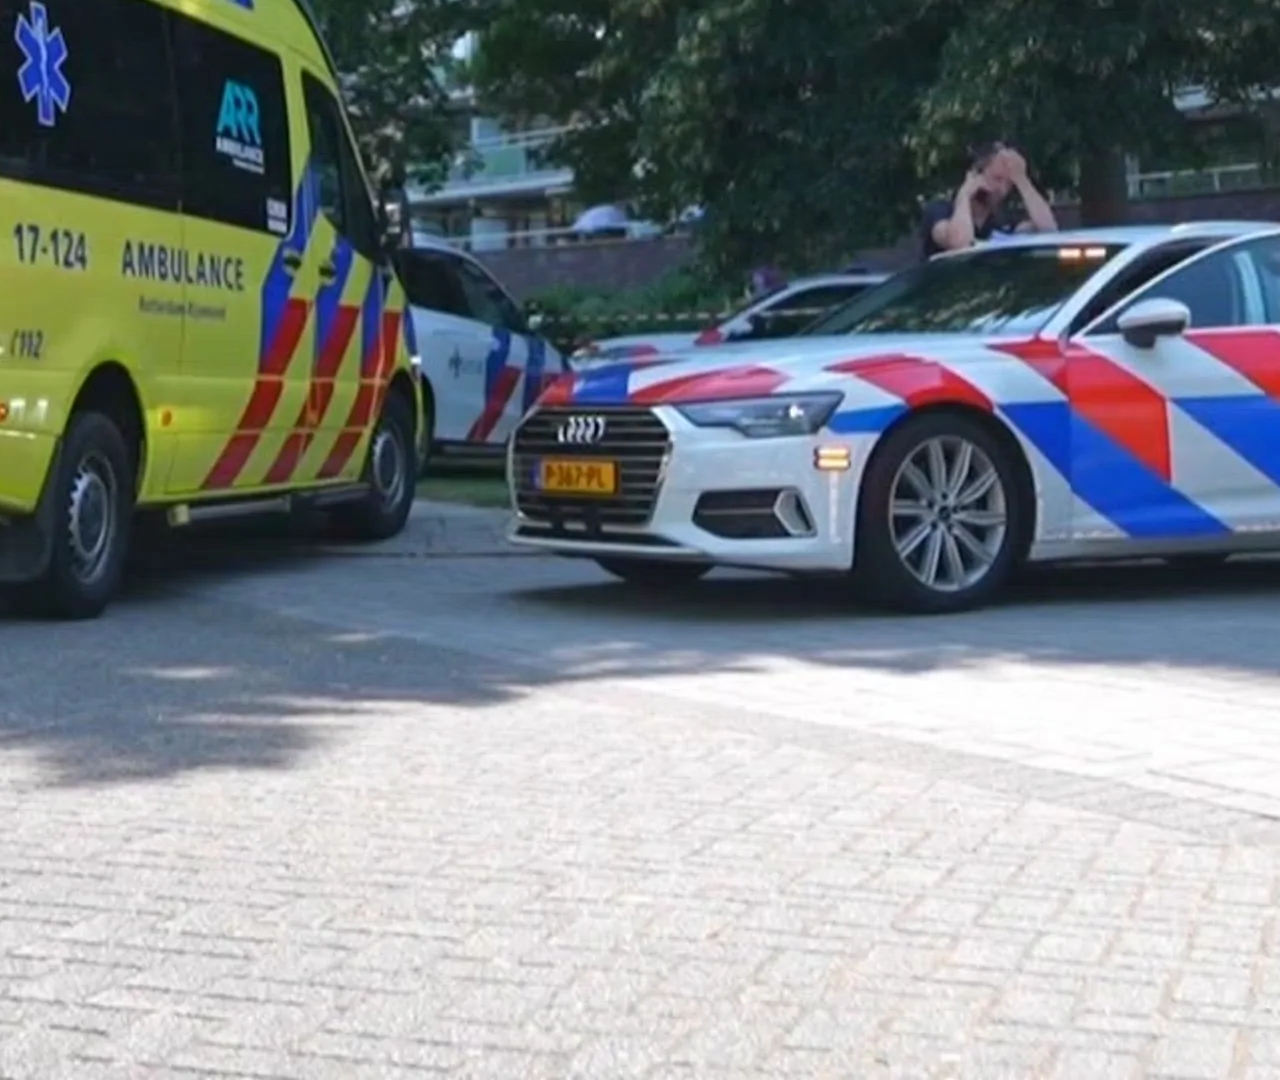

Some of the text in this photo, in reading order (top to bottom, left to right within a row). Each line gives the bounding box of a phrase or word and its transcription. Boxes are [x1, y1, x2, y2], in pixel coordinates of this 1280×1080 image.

[216, 78, 262, 146] ARR
[13, 223, 87, 271] 17-124
[122, 239, 245, 291] AMBULANCE
